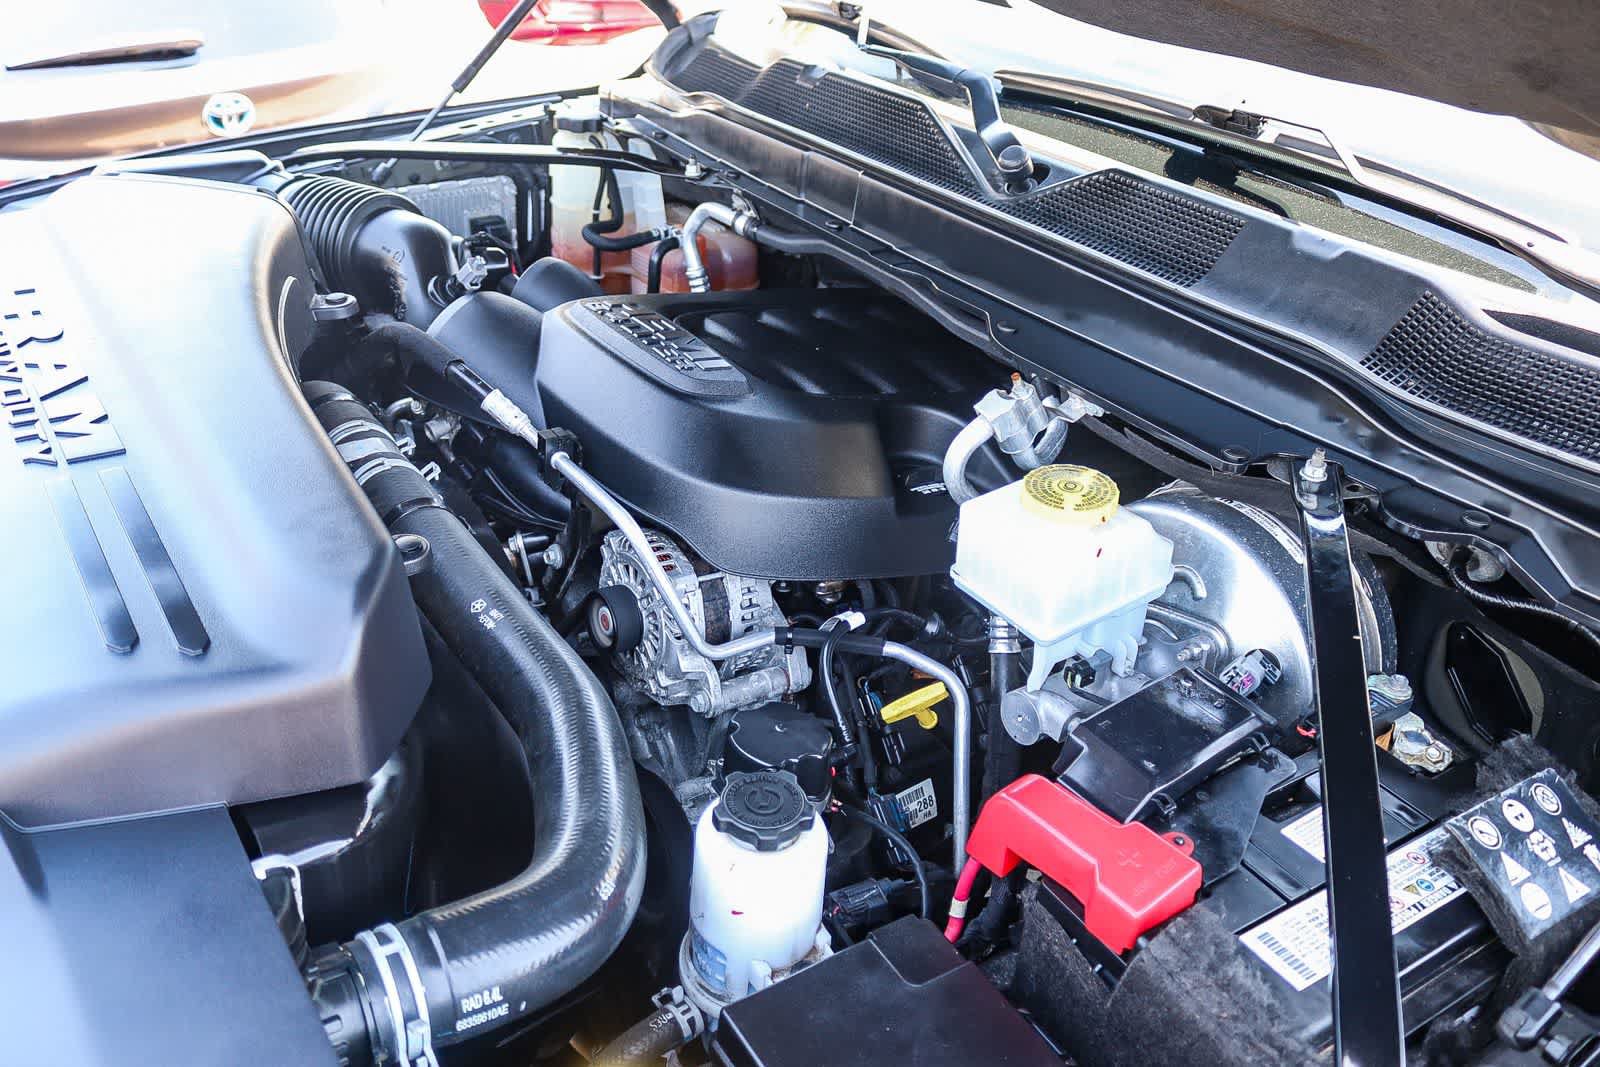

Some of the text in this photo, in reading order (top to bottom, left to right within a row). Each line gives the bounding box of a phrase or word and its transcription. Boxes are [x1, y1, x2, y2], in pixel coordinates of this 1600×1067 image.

[5, 300, 127, 466] RAM
[917, 794, 934, 813] 288
[461, 993, 483, 1014] RAD
